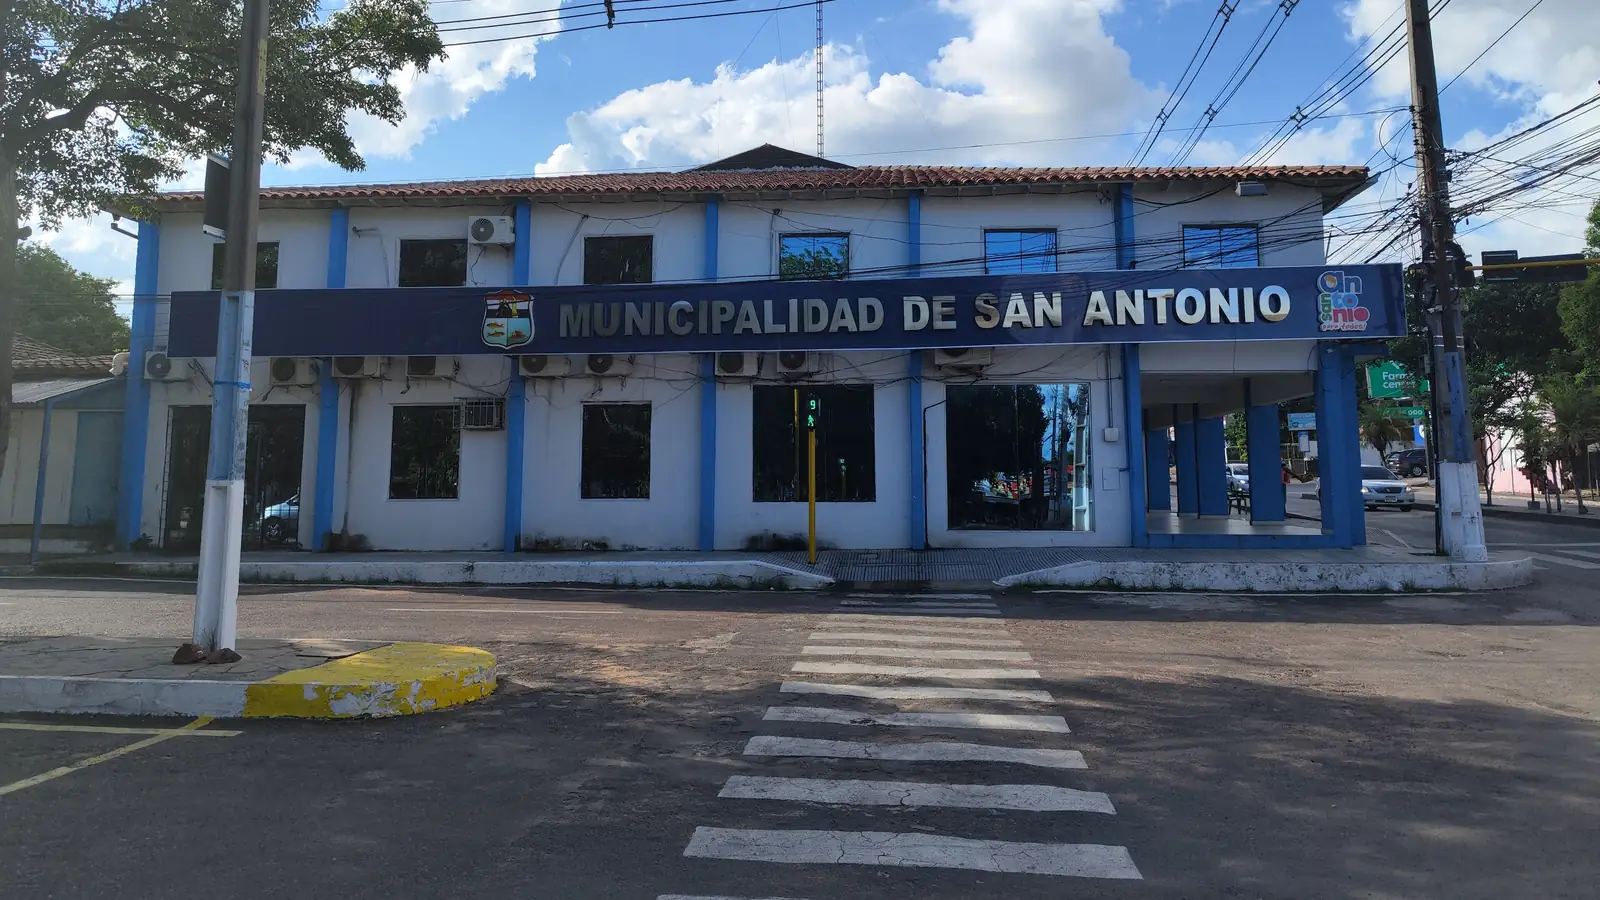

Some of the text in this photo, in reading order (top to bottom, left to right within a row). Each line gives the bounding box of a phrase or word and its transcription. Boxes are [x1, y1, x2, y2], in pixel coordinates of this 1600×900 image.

[559, 285, 1291, 338] MUNICIPALIDAD DE SAN ANTONIO
[810, 400, 816, 409] 9
